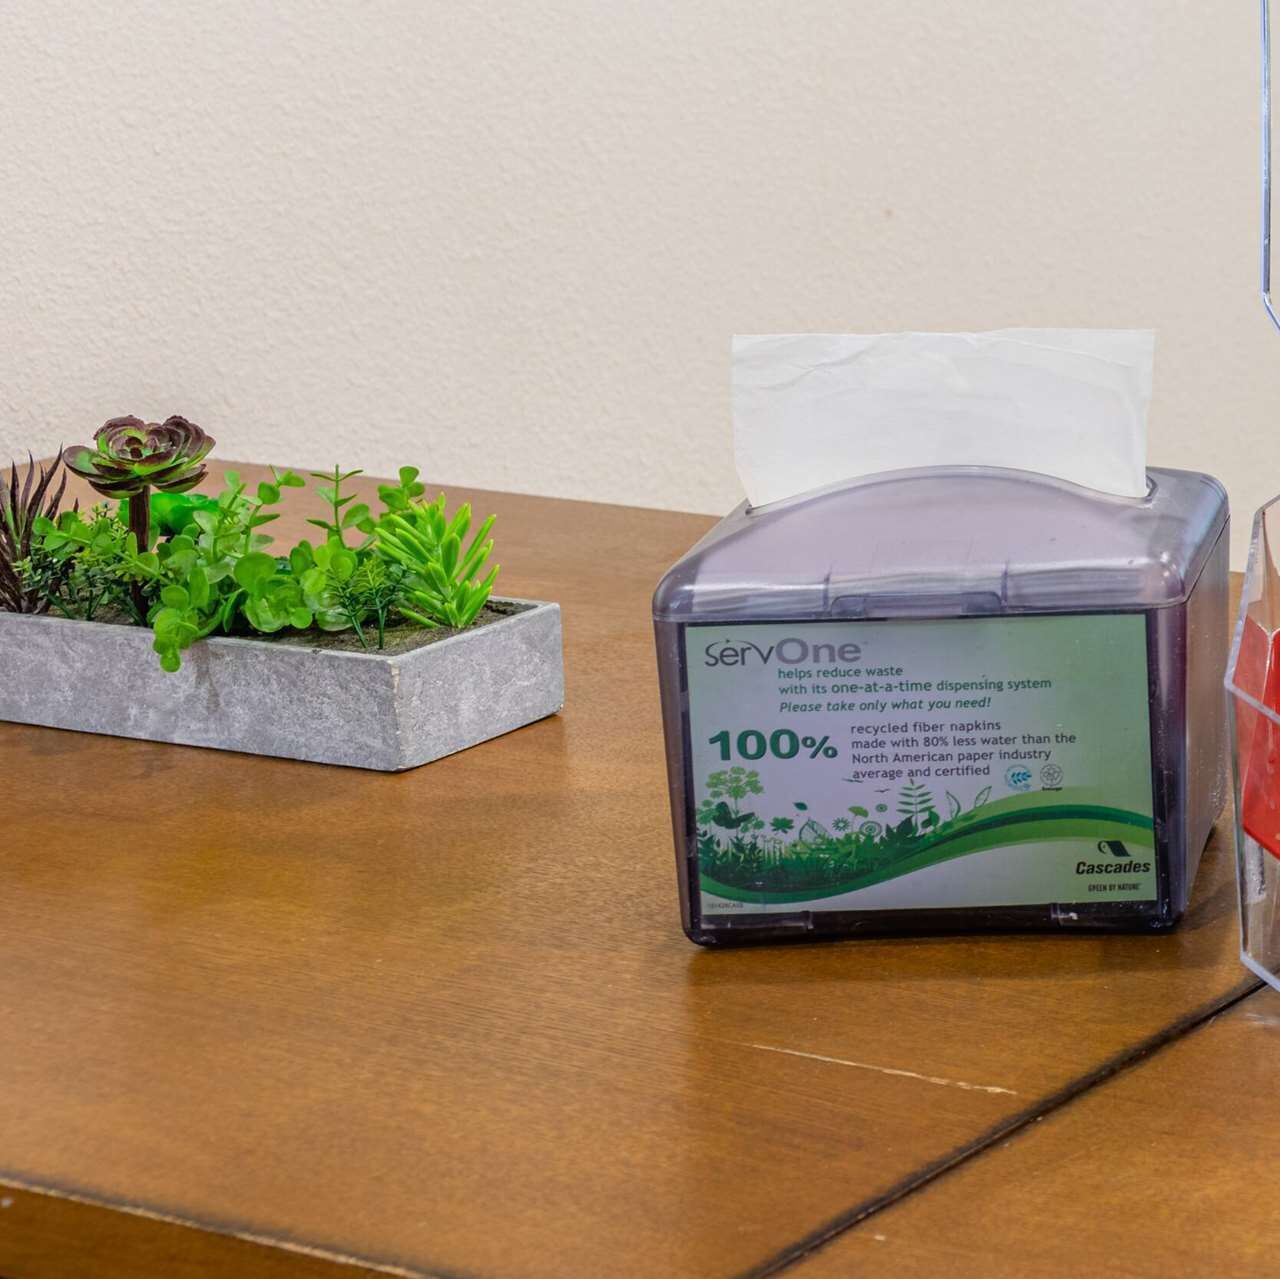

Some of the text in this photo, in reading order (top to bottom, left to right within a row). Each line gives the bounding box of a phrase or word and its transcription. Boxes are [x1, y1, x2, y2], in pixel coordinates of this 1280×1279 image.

[778, 666, 904, 681] helps reduce waste
[778, 678, 1053, 695] with its one-at-a-time dispensing system
[779, 697, 991, 713] Please take only what you need!
[851, 720, 1001, 736] recycled fiber napkins
[707, 728, 839, 761] 100%
[851, 732, 1077, 749] made with 80% less water than the
[851, 748, 1052, 764] North American paper industry
[852, 764, 991, 780] average and certified
[1075, 860, 1151, 875] Cascades
